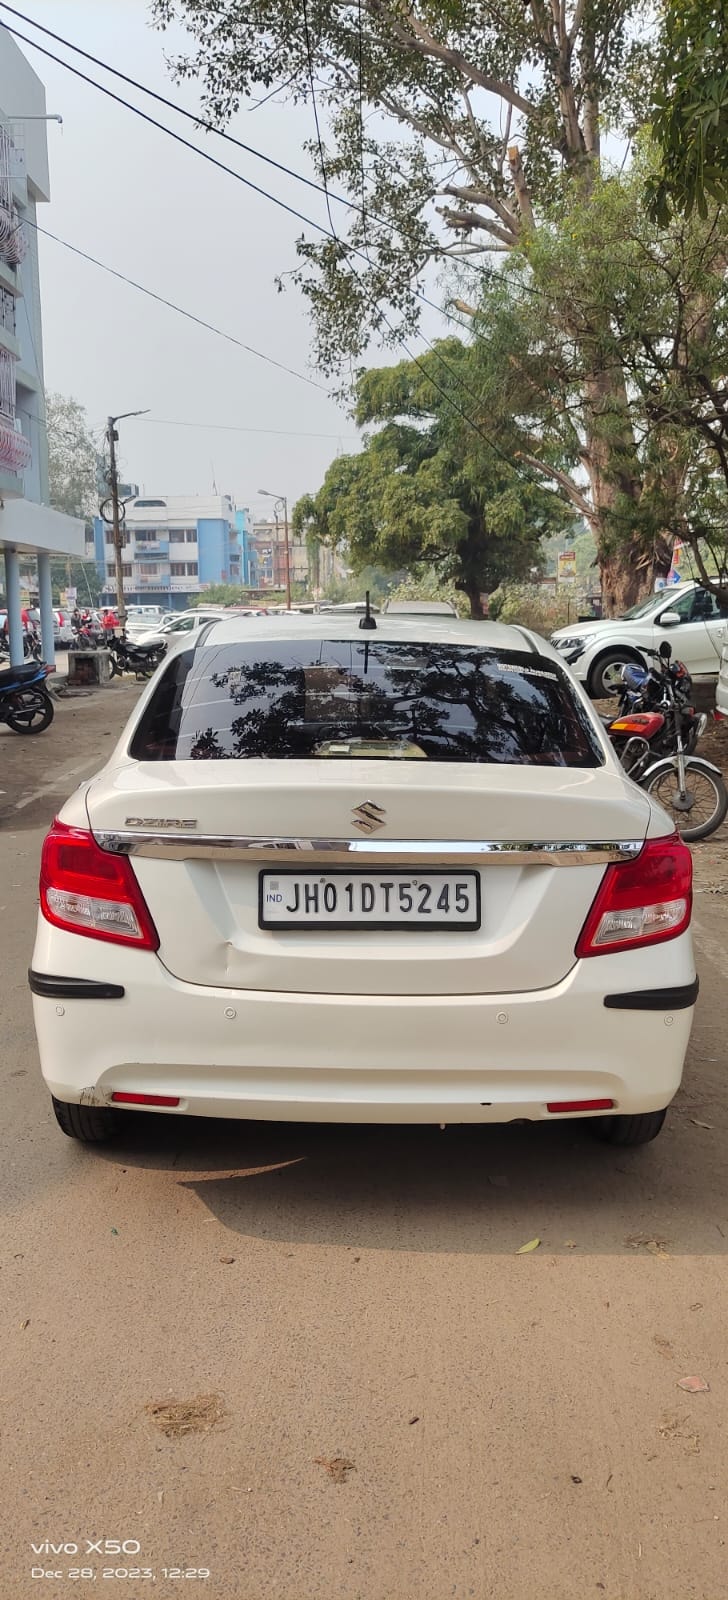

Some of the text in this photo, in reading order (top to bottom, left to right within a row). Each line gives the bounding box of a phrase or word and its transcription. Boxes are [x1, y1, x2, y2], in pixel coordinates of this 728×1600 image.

[125, 817, 197, 829] DZIRE
[266, 894, 283, 903] IND
[286, 882, 470, 914] JH01DT5245
